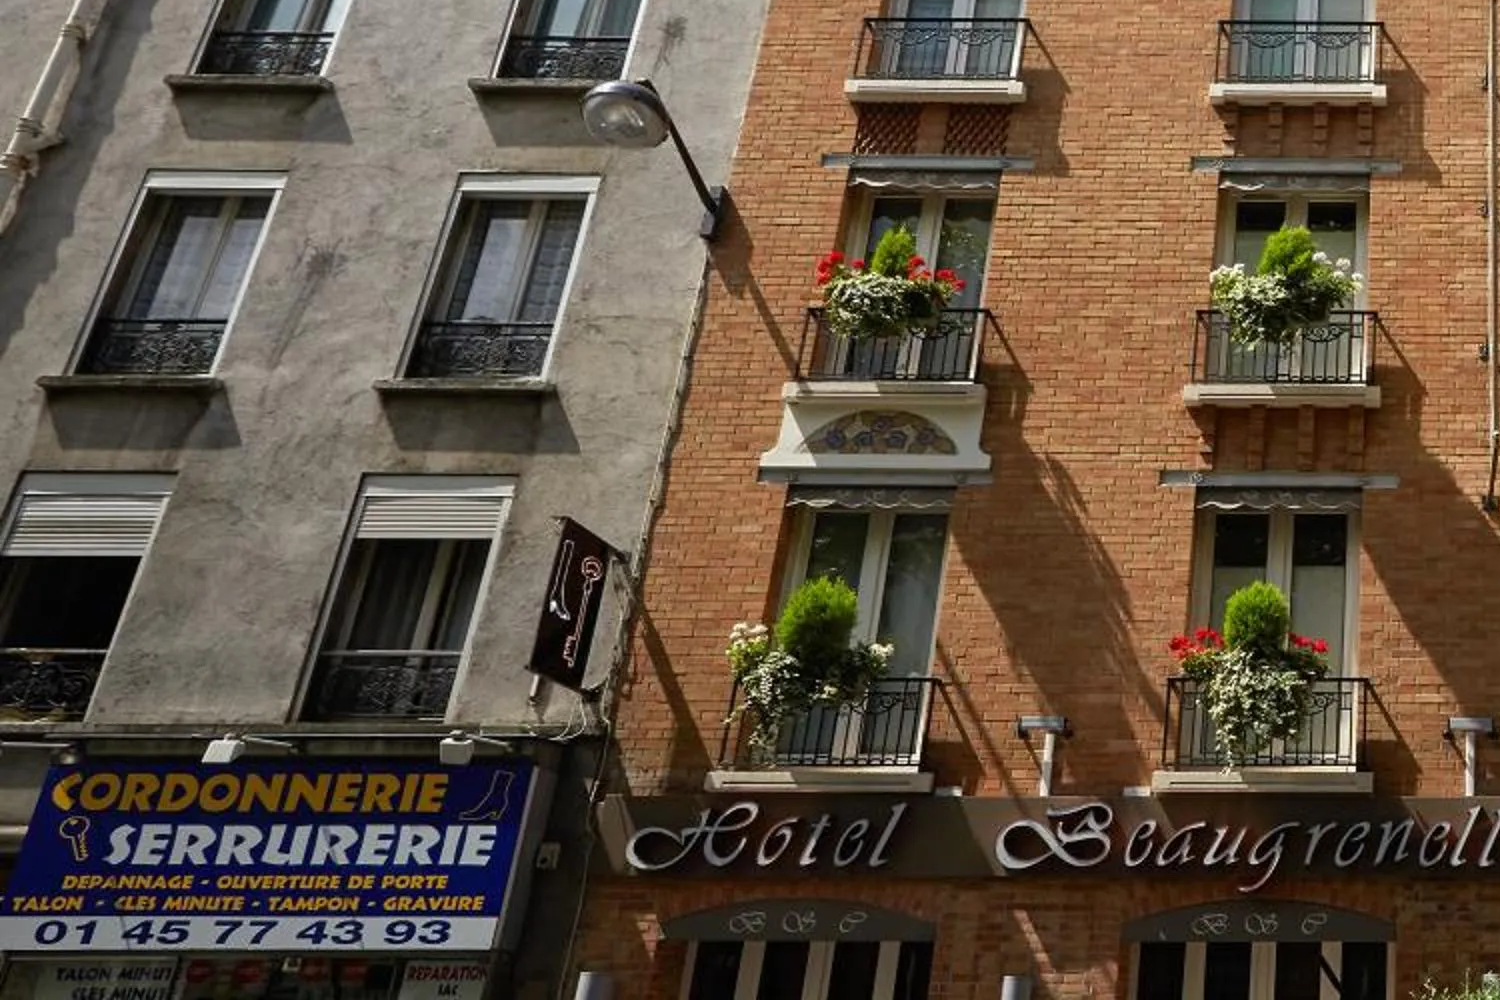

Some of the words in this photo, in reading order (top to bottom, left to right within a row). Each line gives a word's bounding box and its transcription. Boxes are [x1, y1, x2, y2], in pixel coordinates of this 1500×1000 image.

[51, 772, 450, 814] CORDONNERIE
[103, 823, 498, 867] SERRURERIE
[61, 874, 194, 890] DEPANNAGE
[216, 874, 341, 890] OUVERTURE
[347, 875, 377, 890] DE
[382, 875, 449, 890] PORTE
[12, 896, 84, 911] TALON
[114, 896, 157, 911] CLES
[162, 896, 244, 911] MINUTE
[267, 896, 360, 911] TAMPON
[383, 896, 484, 911] GRAVURE
[35, 920, 97, 945] 01
[122, 920, 190, 945] 45
[214, 920, 278, 945] 77
[295, 920, 365, 945] 43
[383, 920, 452, 945] 93
[56, 968, 111, 981] TALON
